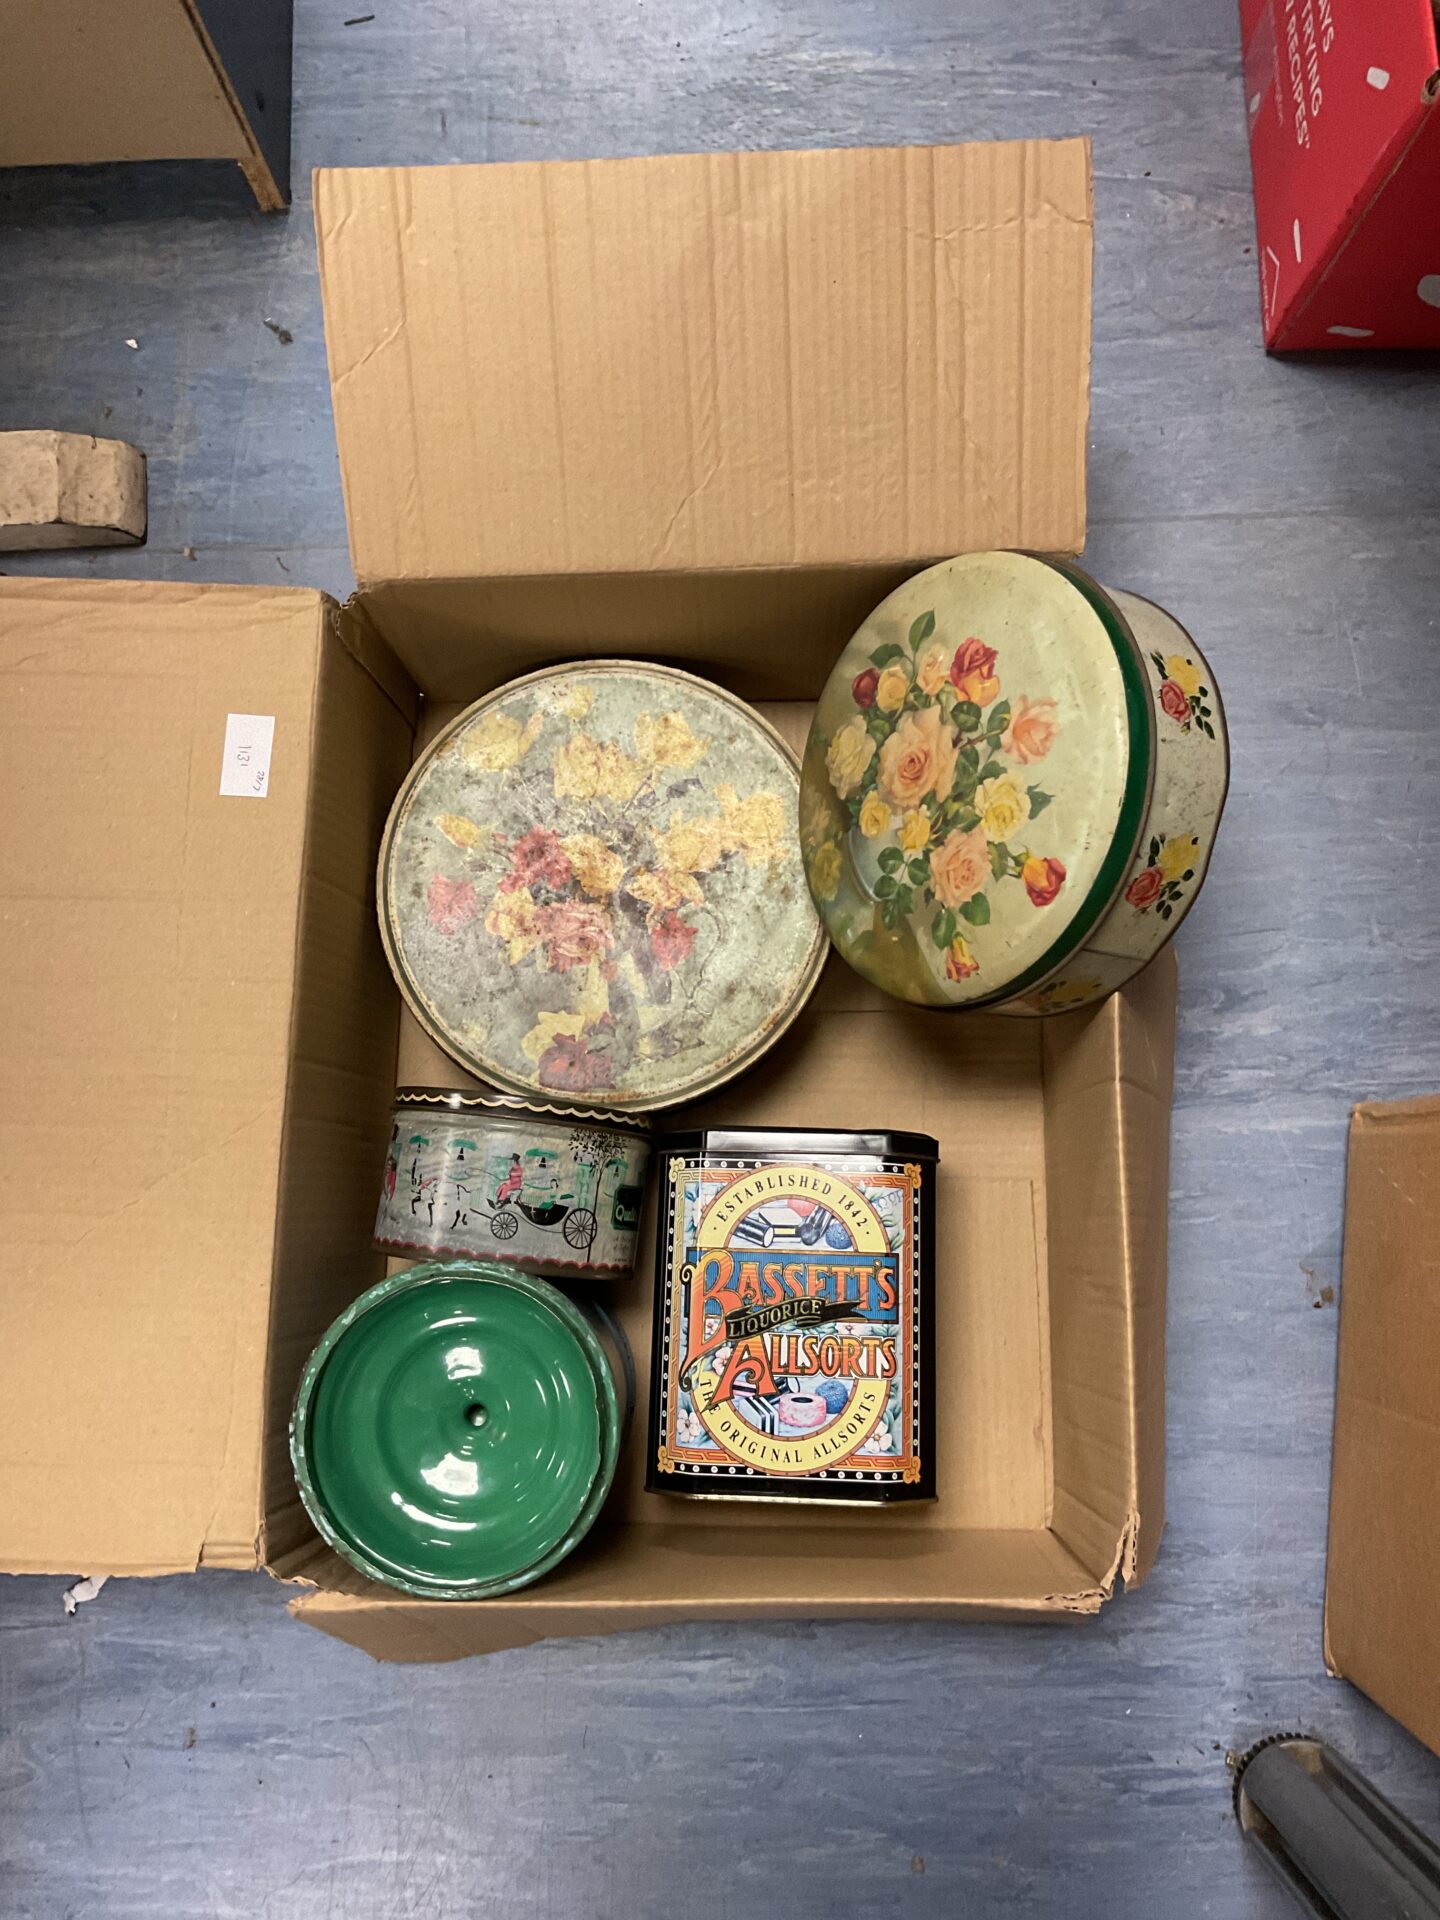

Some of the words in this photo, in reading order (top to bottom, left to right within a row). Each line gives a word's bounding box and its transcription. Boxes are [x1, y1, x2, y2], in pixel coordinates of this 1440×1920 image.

[1301, 0, 1322, 117] TRYING
[716, 1174, 832, 1222] ESTABLISHED
[837, 1194, 868, 1227] 1842
[680, 1249, 898, 1391] BASSETT'S
[729, 1300, 822, 1337] LIQUORICE
[701, 1333, 898, 1412] ALLSORTS
[720, 1420, 803, 1463] ORIGINAL
[812, 1391, 876, 1459] ALLSORTS
